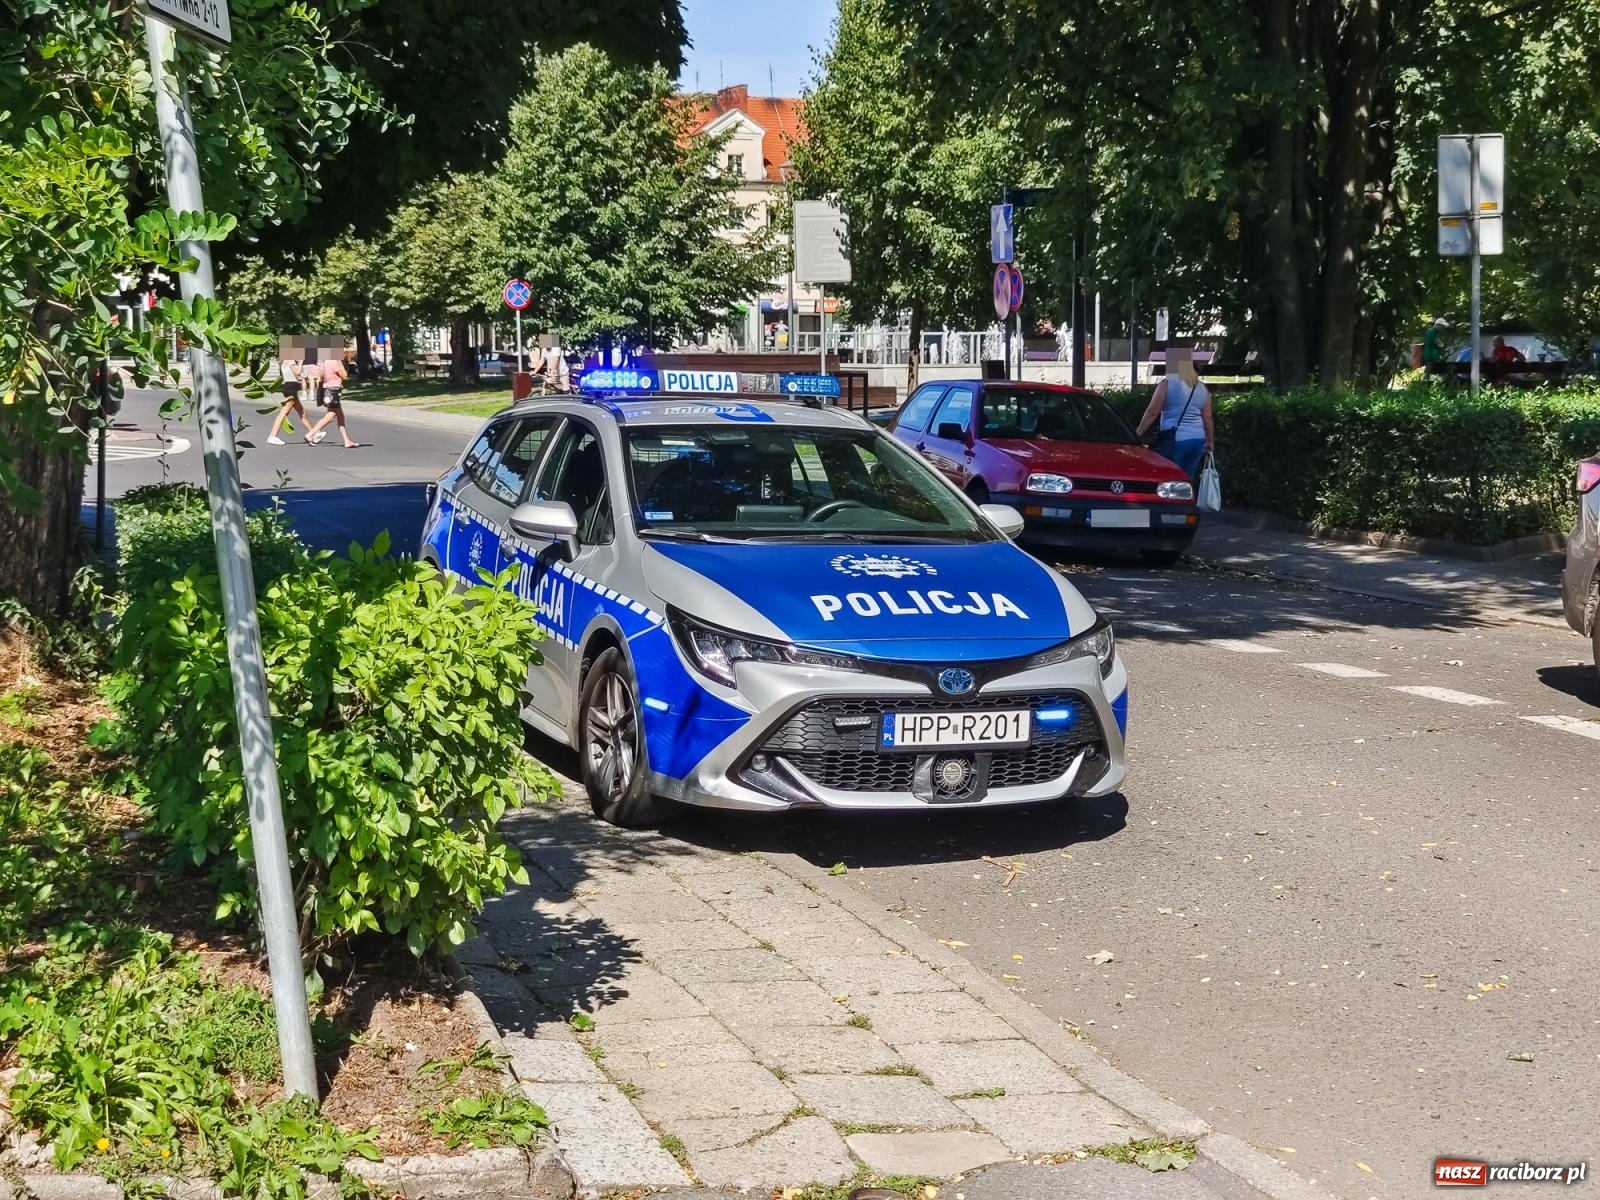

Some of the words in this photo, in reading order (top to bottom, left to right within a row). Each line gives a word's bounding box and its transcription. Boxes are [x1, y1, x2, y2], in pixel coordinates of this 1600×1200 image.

[668, 373, 734, 391] POLICJA
[810, 590, 1030, 621] POLICJA
[901, 716, 950, 743] HPP
[962, 713, 1020, 741] R201
